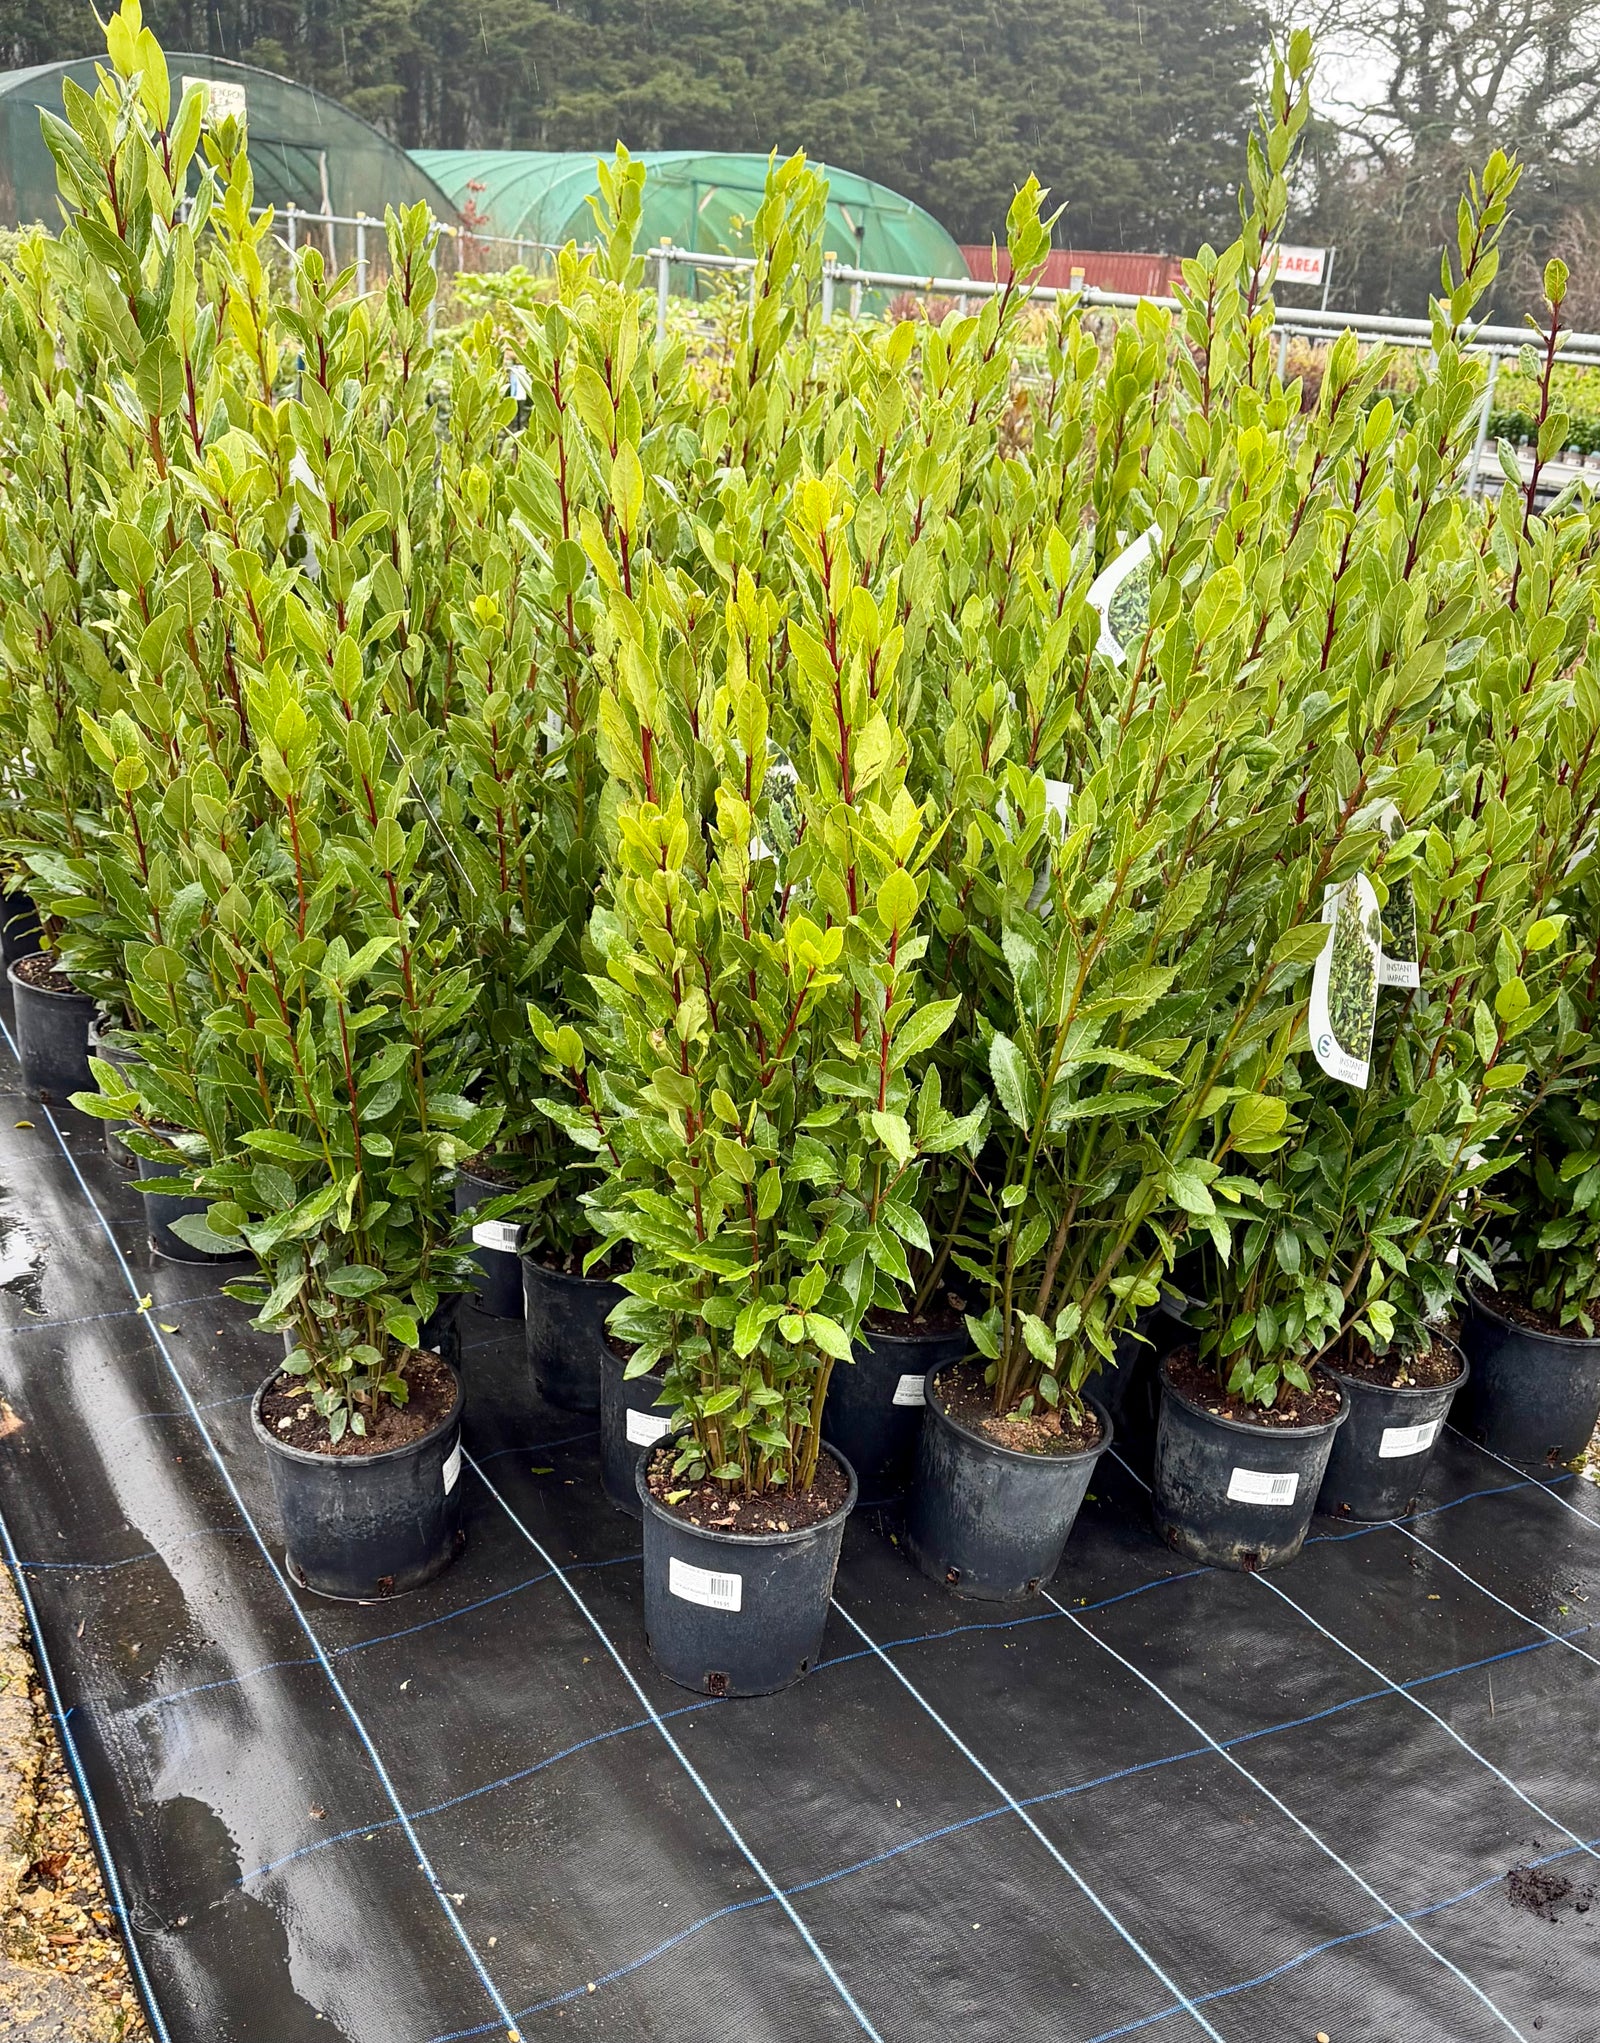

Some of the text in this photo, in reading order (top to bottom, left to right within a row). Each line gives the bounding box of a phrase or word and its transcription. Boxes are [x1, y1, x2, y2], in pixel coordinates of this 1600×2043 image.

[1285, 256, 1319, 273] AREA
[1386, 963, 1412, 973] INSTANT
[1387, 974, 1410, 983] IMPACT
[1339, 1057, 1364, 1073] INSTANT
[1337, 1067, 1359, 1083] IMPACT
